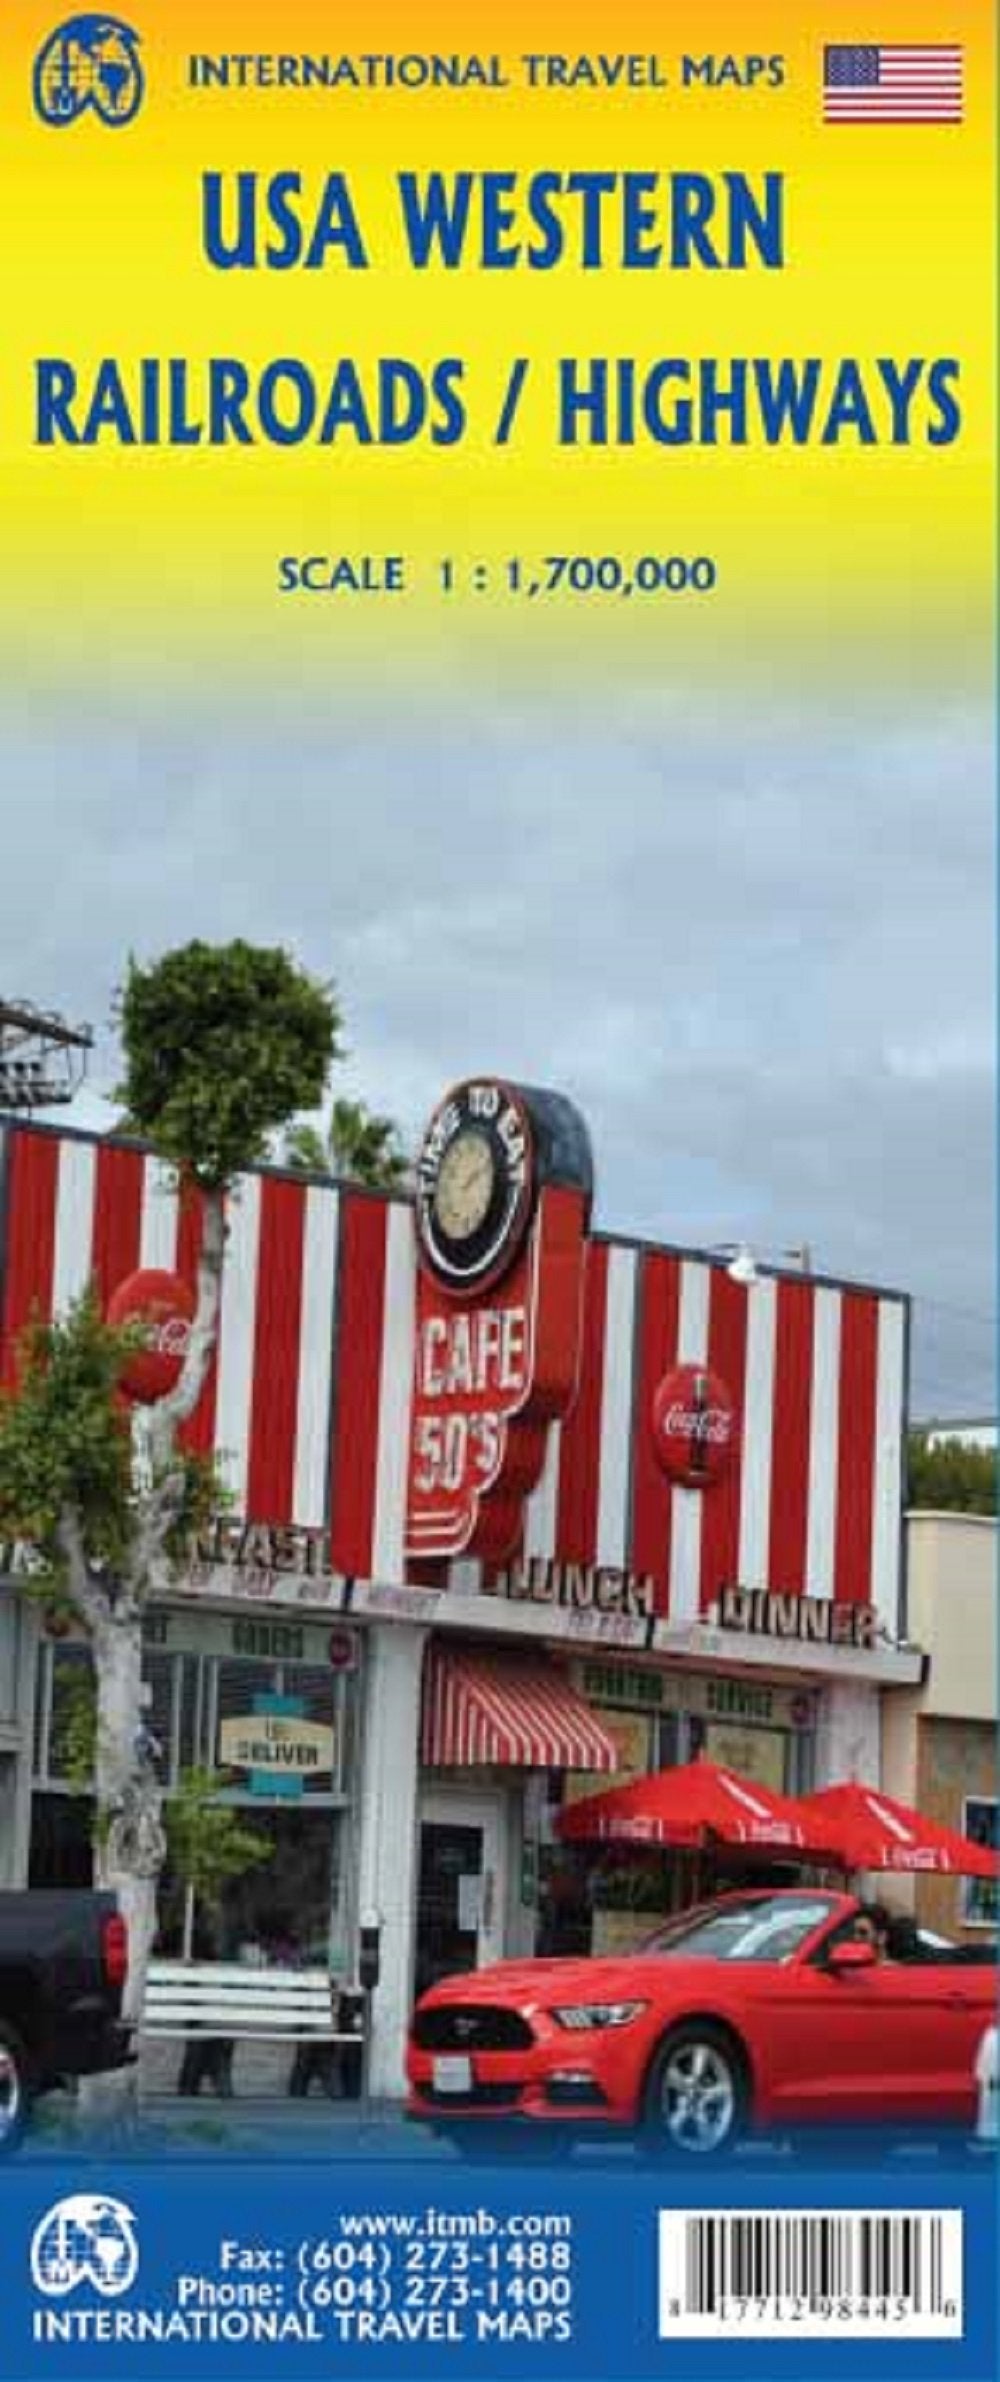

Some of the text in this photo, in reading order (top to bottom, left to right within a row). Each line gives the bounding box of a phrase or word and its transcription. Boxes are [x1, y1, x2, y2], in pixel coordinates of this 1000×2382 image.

[189, 55, 785, 87] INTERNATIONAL TRAVEL MAPS
[202, 171, 785, 270] USA WESTERN
[35, 358, 961, 446] RAILROADS / HIGHWAYS
[279, 557, 404, 591] SCALE
[439, 559, 452, 591] 1
[508, 557, 716, 595] 1,700,000
[420, 1085, 526, 1195] TIME TO EAT
[421, 1305, 528, 1397] CAFE
[413, 1409, 500, 1491] 50'S
[492, 1557, 653, 1619] LUNCH
[717, 1582, 878, 1650] DINNER
[339, 2209, 571, 2236] www.itmb.com
[220, 2240, 571, 2275] Fax: (604) 273-1488
[177, 2276, 571, 2310] Phone: (604) 273-1400
[719, 2298, 804, 2321] 17712
[820, 2298, 909, 2321] 98445
[33, 2310, 571, 2341] INTERNATIONAL TRAVEL MAPS
